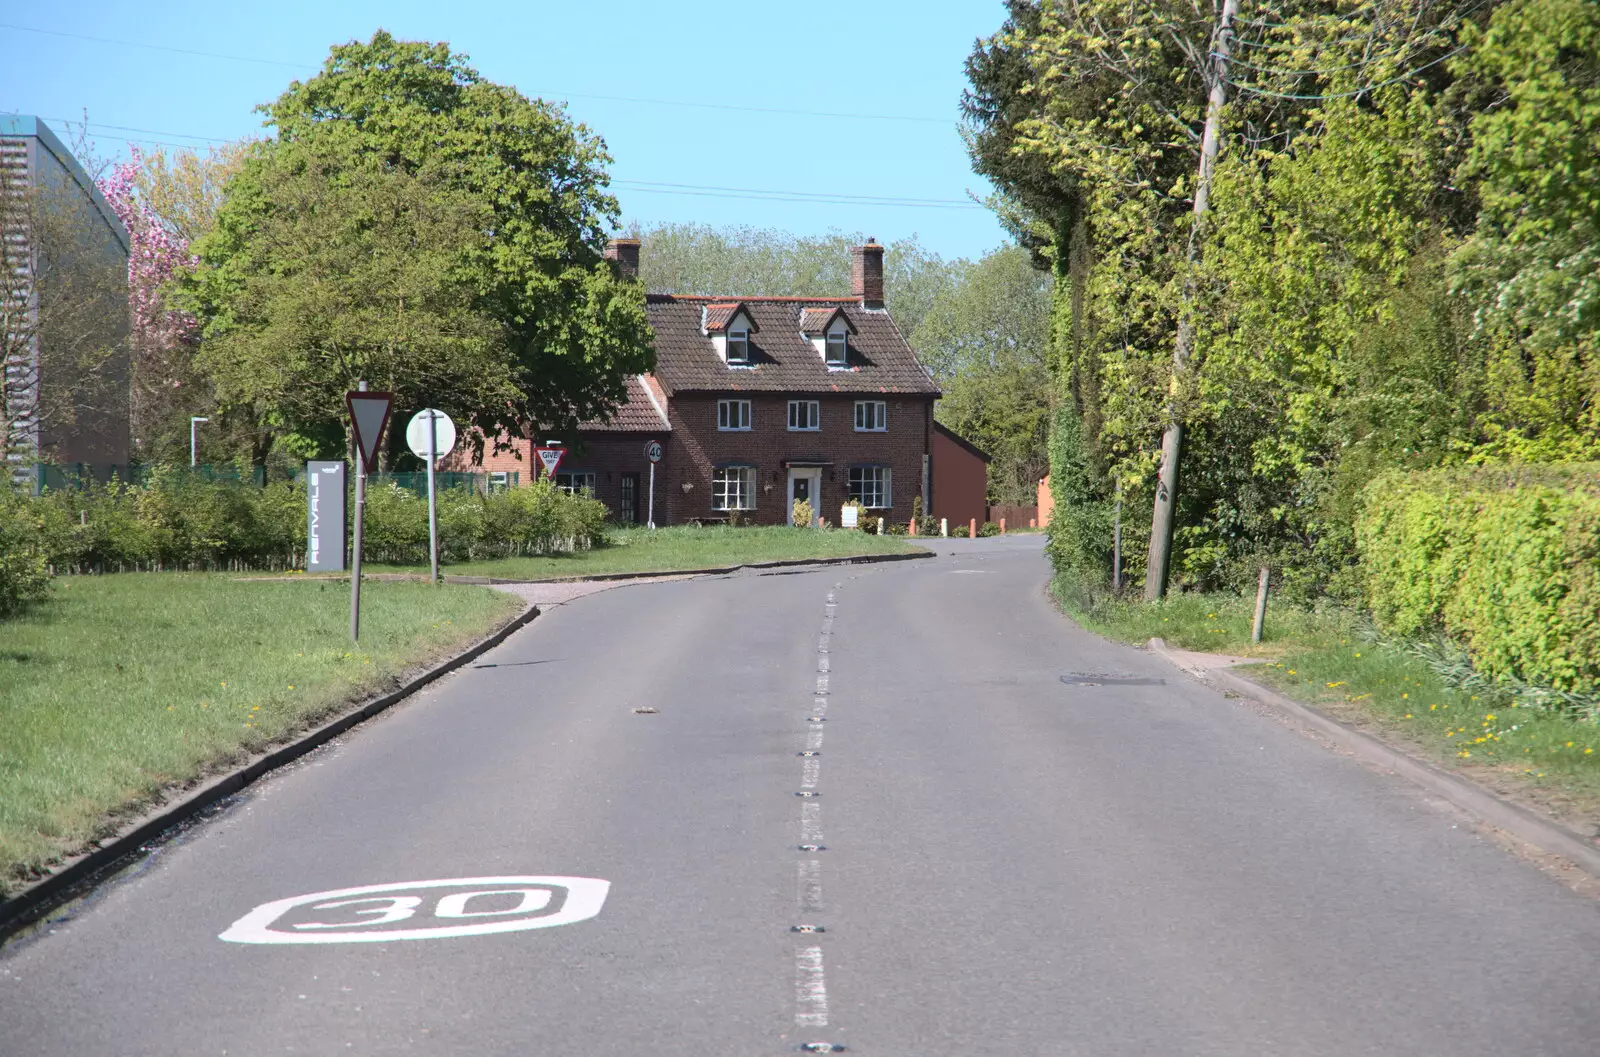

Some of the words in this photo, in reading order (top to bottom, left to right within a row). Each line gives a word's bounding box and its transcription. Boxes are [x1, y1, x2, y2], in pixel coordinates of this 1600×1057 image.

[542, 451, 558, 459] GIVE
[650, 446, 661, 457] 40
[311, 472, 319, 564] RENVALE
[292, 889, 552, 929] 30
